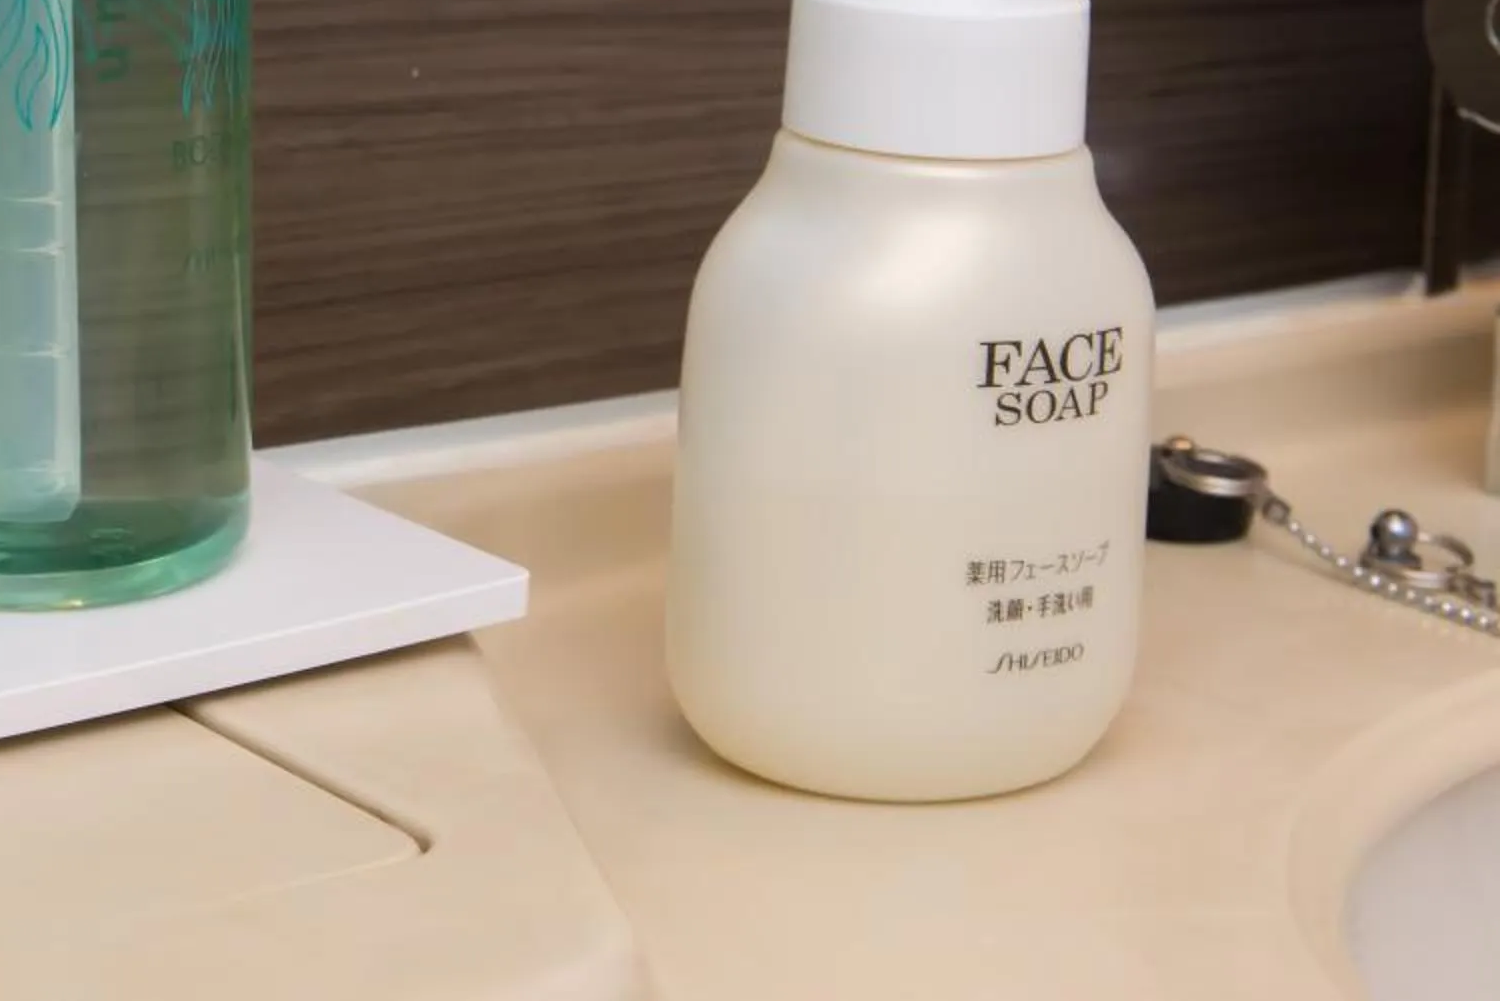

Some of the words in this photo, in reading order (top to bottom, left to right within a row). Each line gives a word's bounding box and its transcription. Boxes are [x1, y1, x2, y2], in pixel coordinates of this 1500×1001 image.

[976, 326, 1123, 388] FACE
[994, 381, 1109, 426] SOAP
[985, 642, 1086, 675] SHISEIDO
